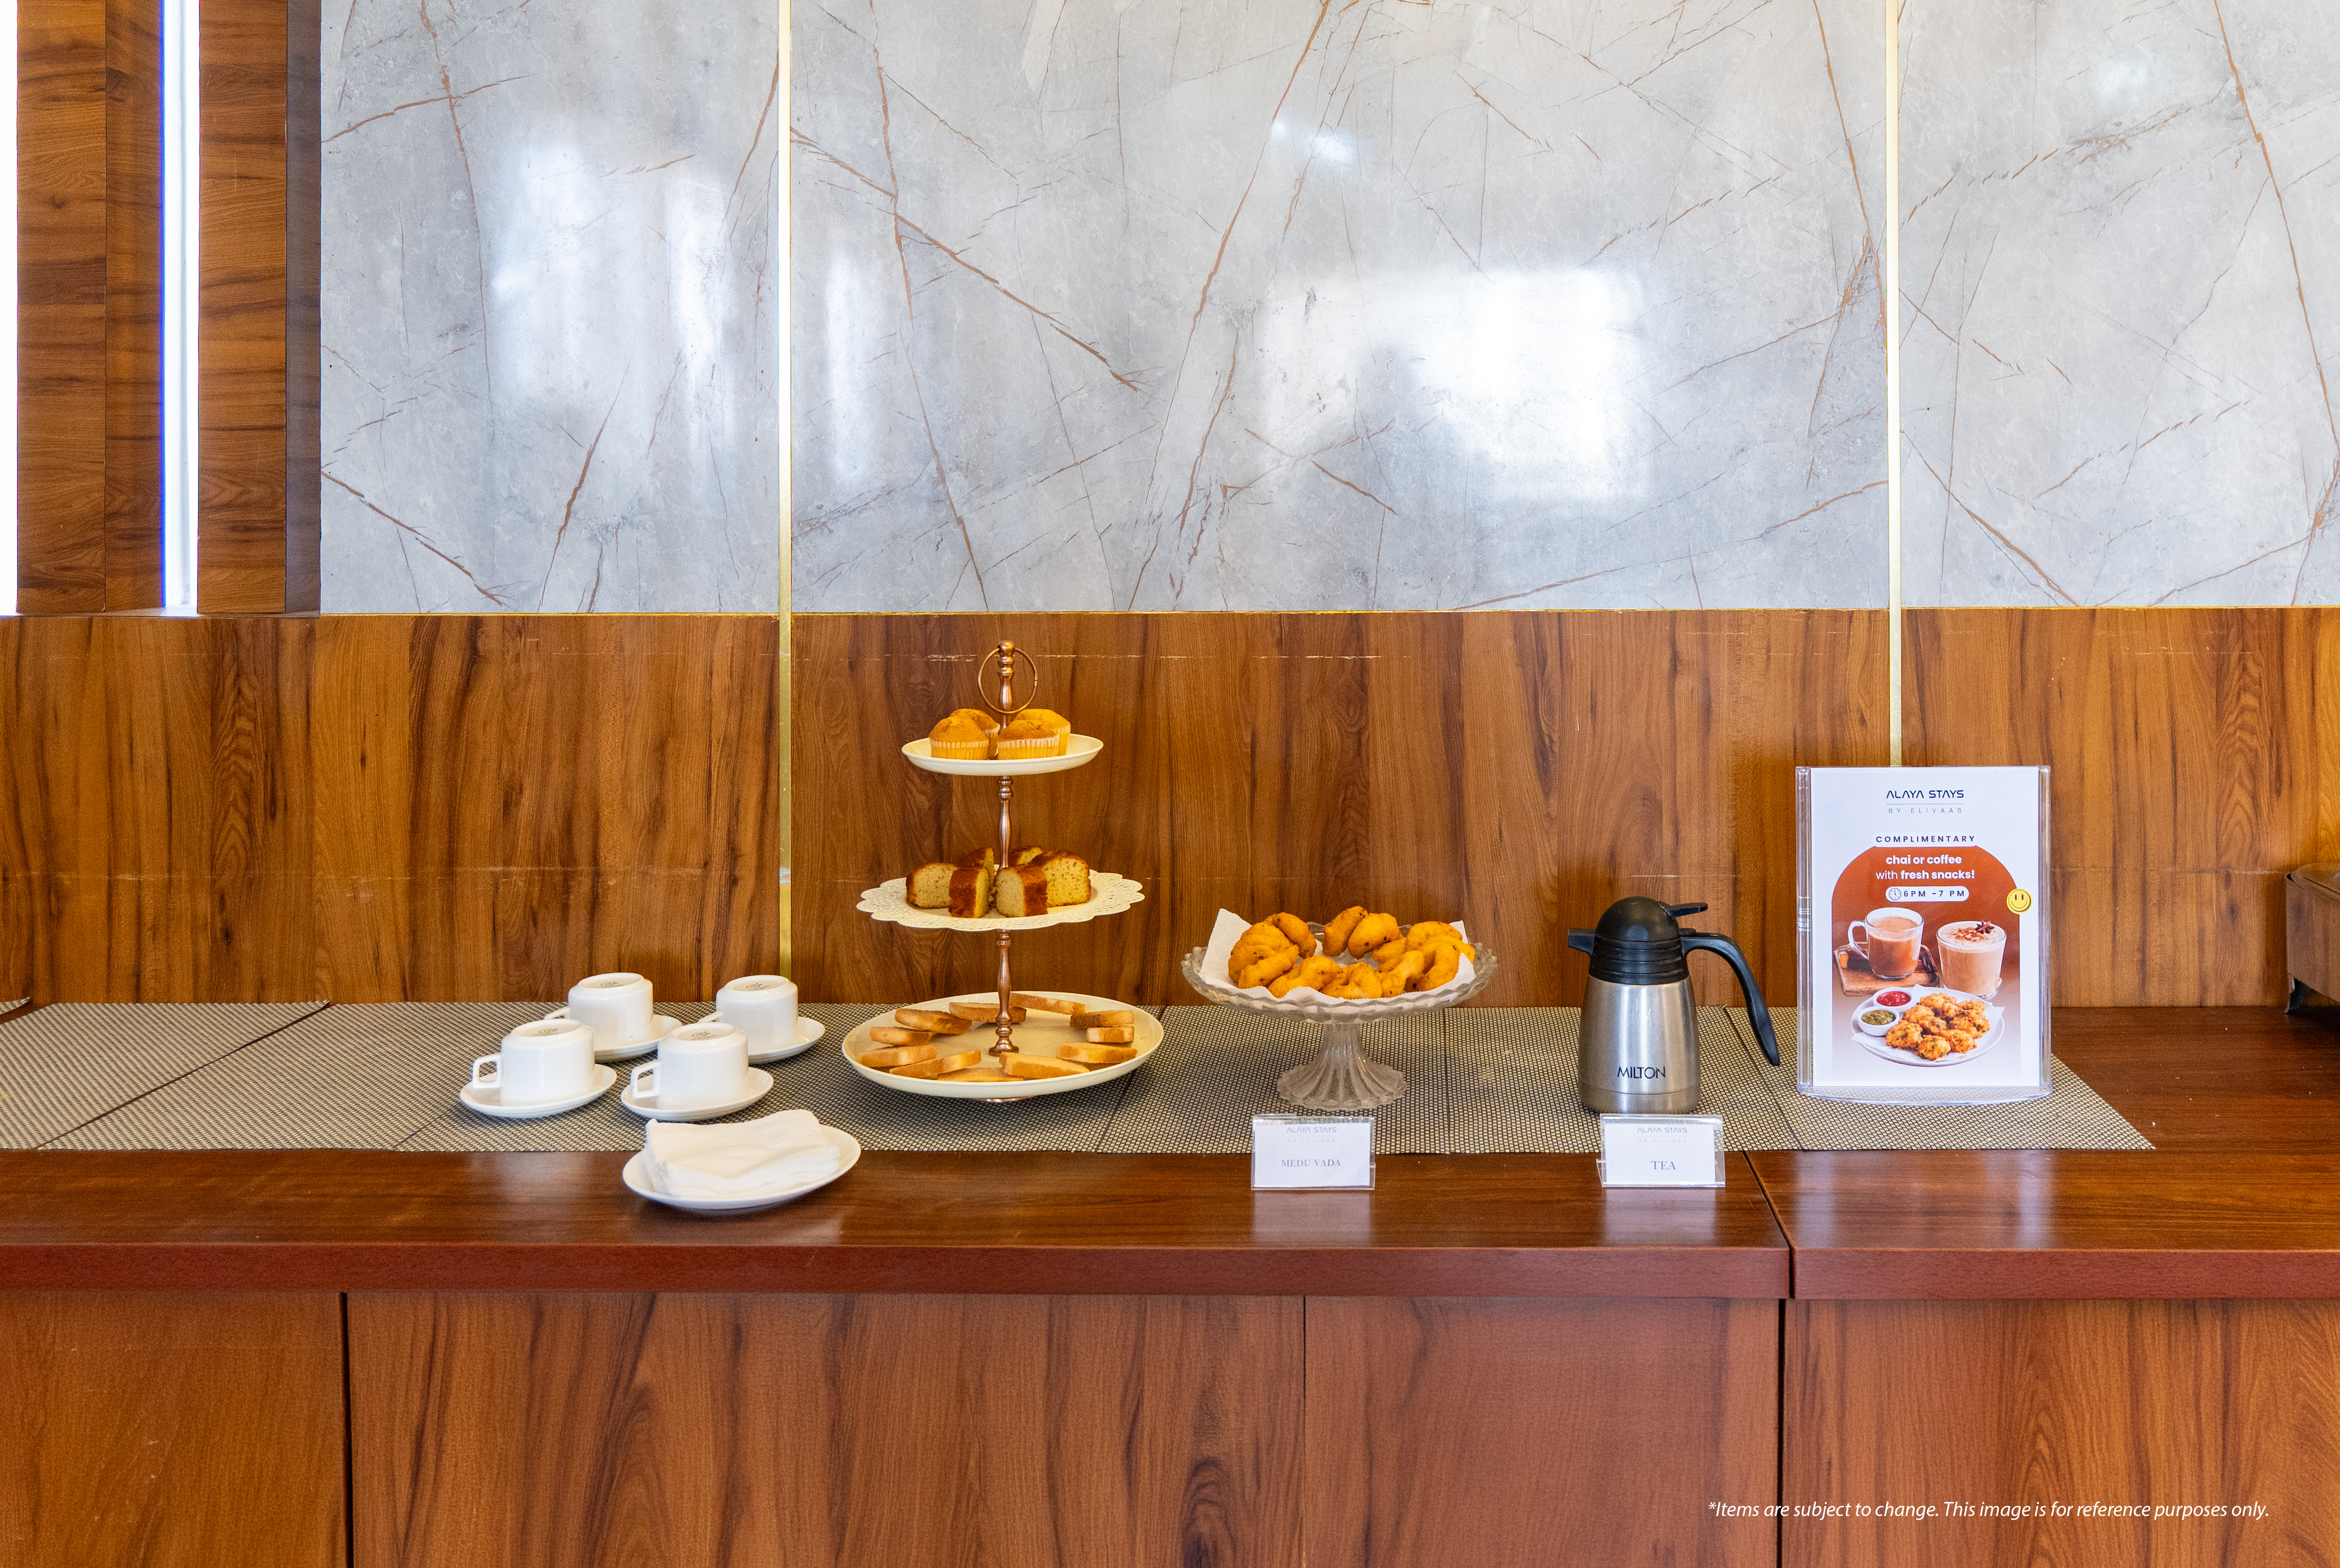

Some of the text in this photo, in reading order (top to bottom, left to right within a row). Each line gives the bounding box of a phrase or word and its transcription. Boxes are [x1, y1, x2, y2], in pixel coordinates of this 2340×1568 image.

[1886, 790, 1964, 799] ALAYA STAYS
[1886, 854, 1911, 865] chai
[1927, 854, 1962, 864] coffee
[1875, 869, 1975, 880] with fresh snacks!
[1617, 1066, 1666, 1079] MILTON
[1281, 1159, 1311, 1168] MEDU
[1651, 1161, 1676, 1170] TEA
